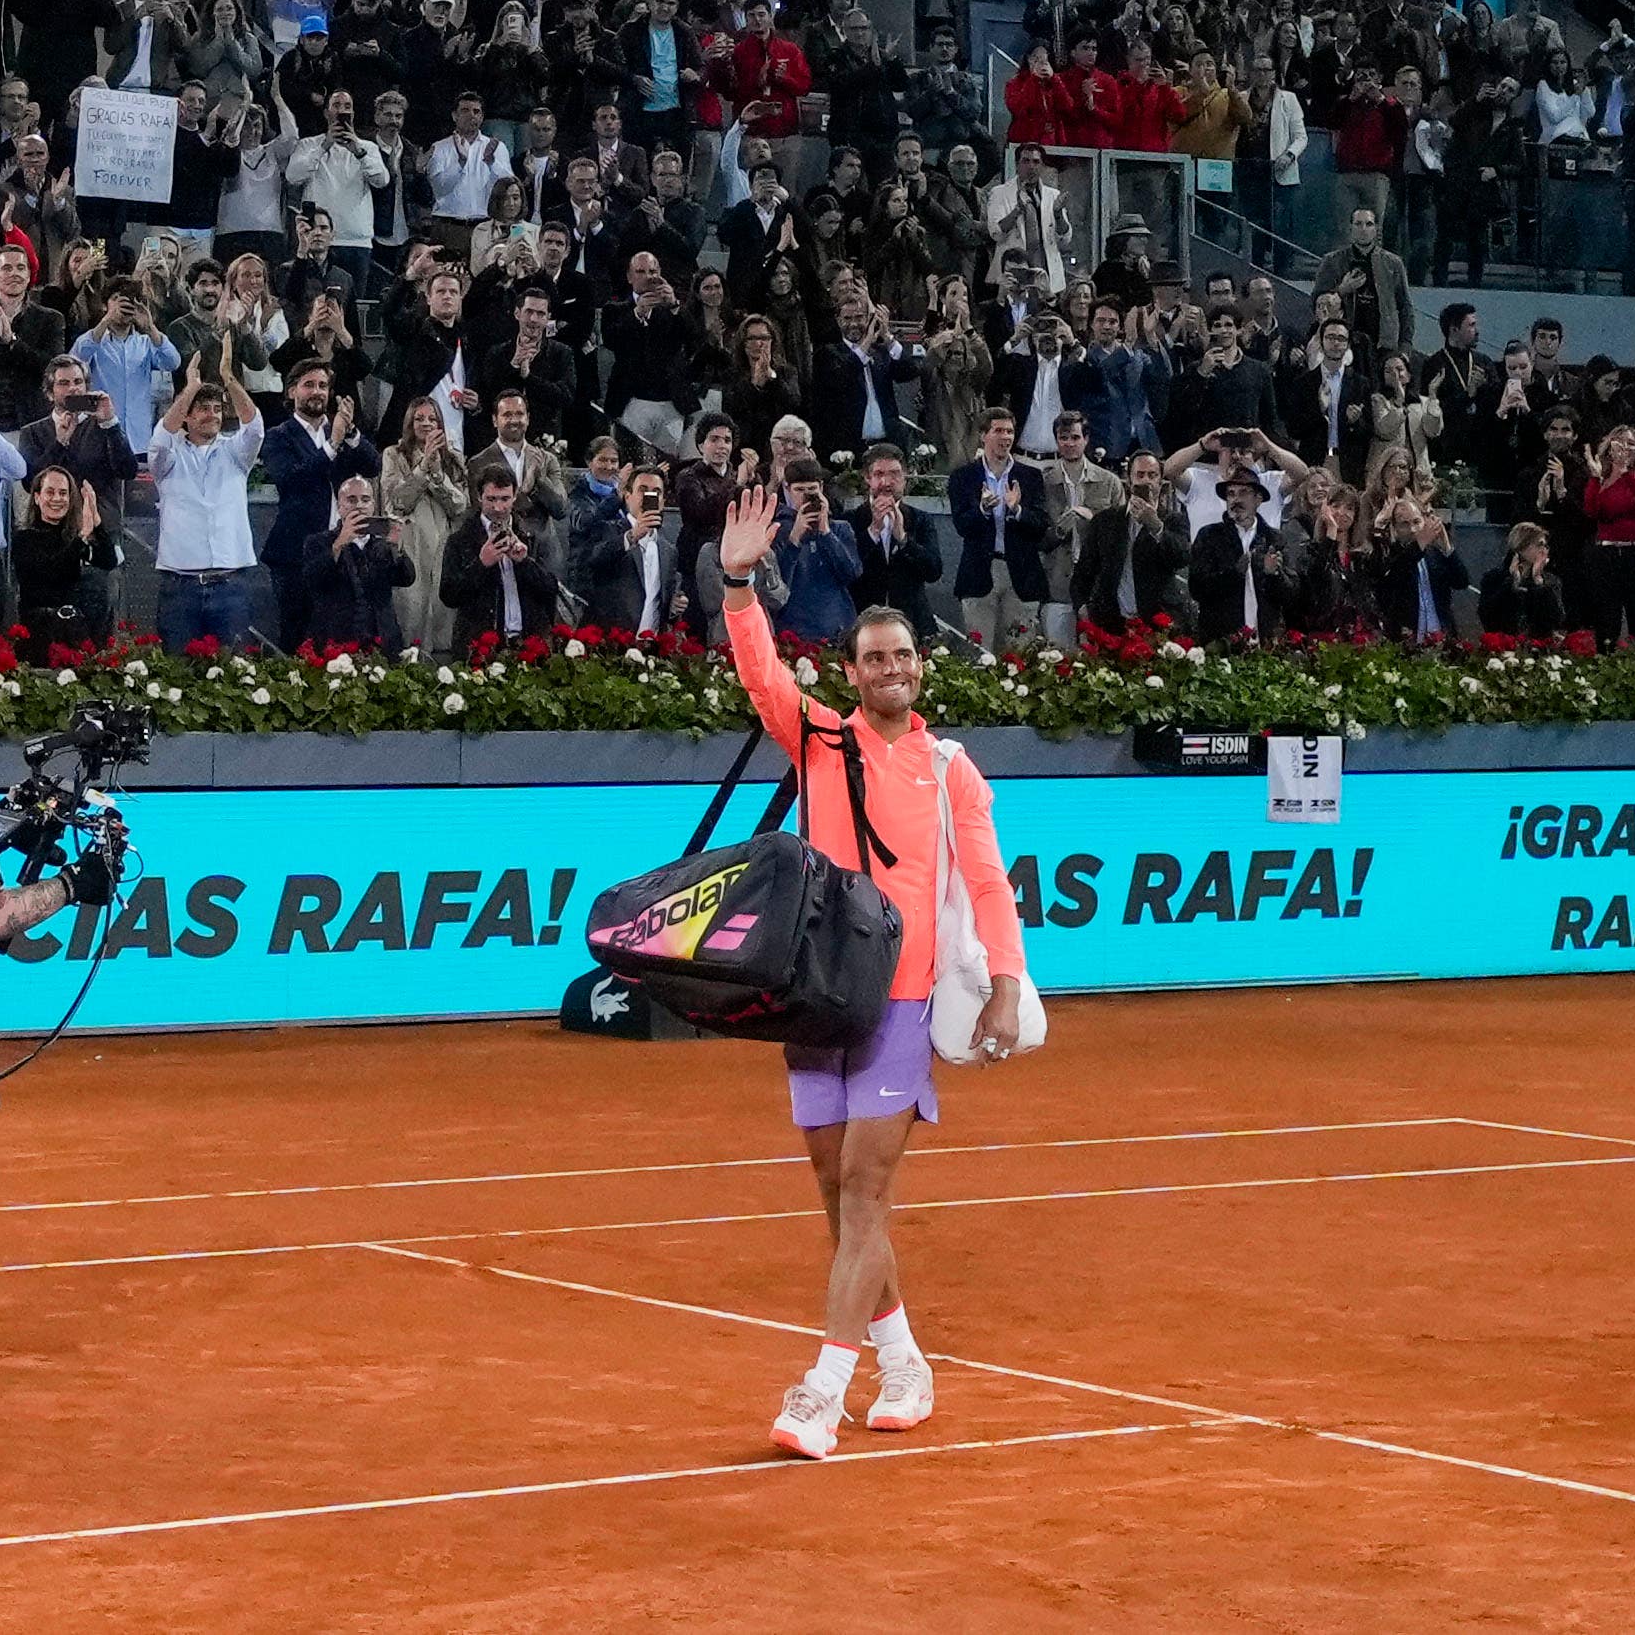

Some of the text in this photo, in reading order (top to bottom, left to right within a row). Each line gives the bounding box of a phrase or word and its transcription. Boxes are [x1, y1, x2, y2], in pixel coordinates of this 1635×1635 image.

[86, 107, 135, 126] GRACIAS
[93, 169, 153, 189] FOREVER
[1181, 754, 1249, 765] LOVE YOUR SKIN
[1211, 736, 1249, 754] ISDIN
[1302, 735, 1319, 778] DIN
[1122, 847, 1374, 925] RAFA!
[268, 868, 577, 954] RAFA!
[609, 870, 743, 949] Babolat
